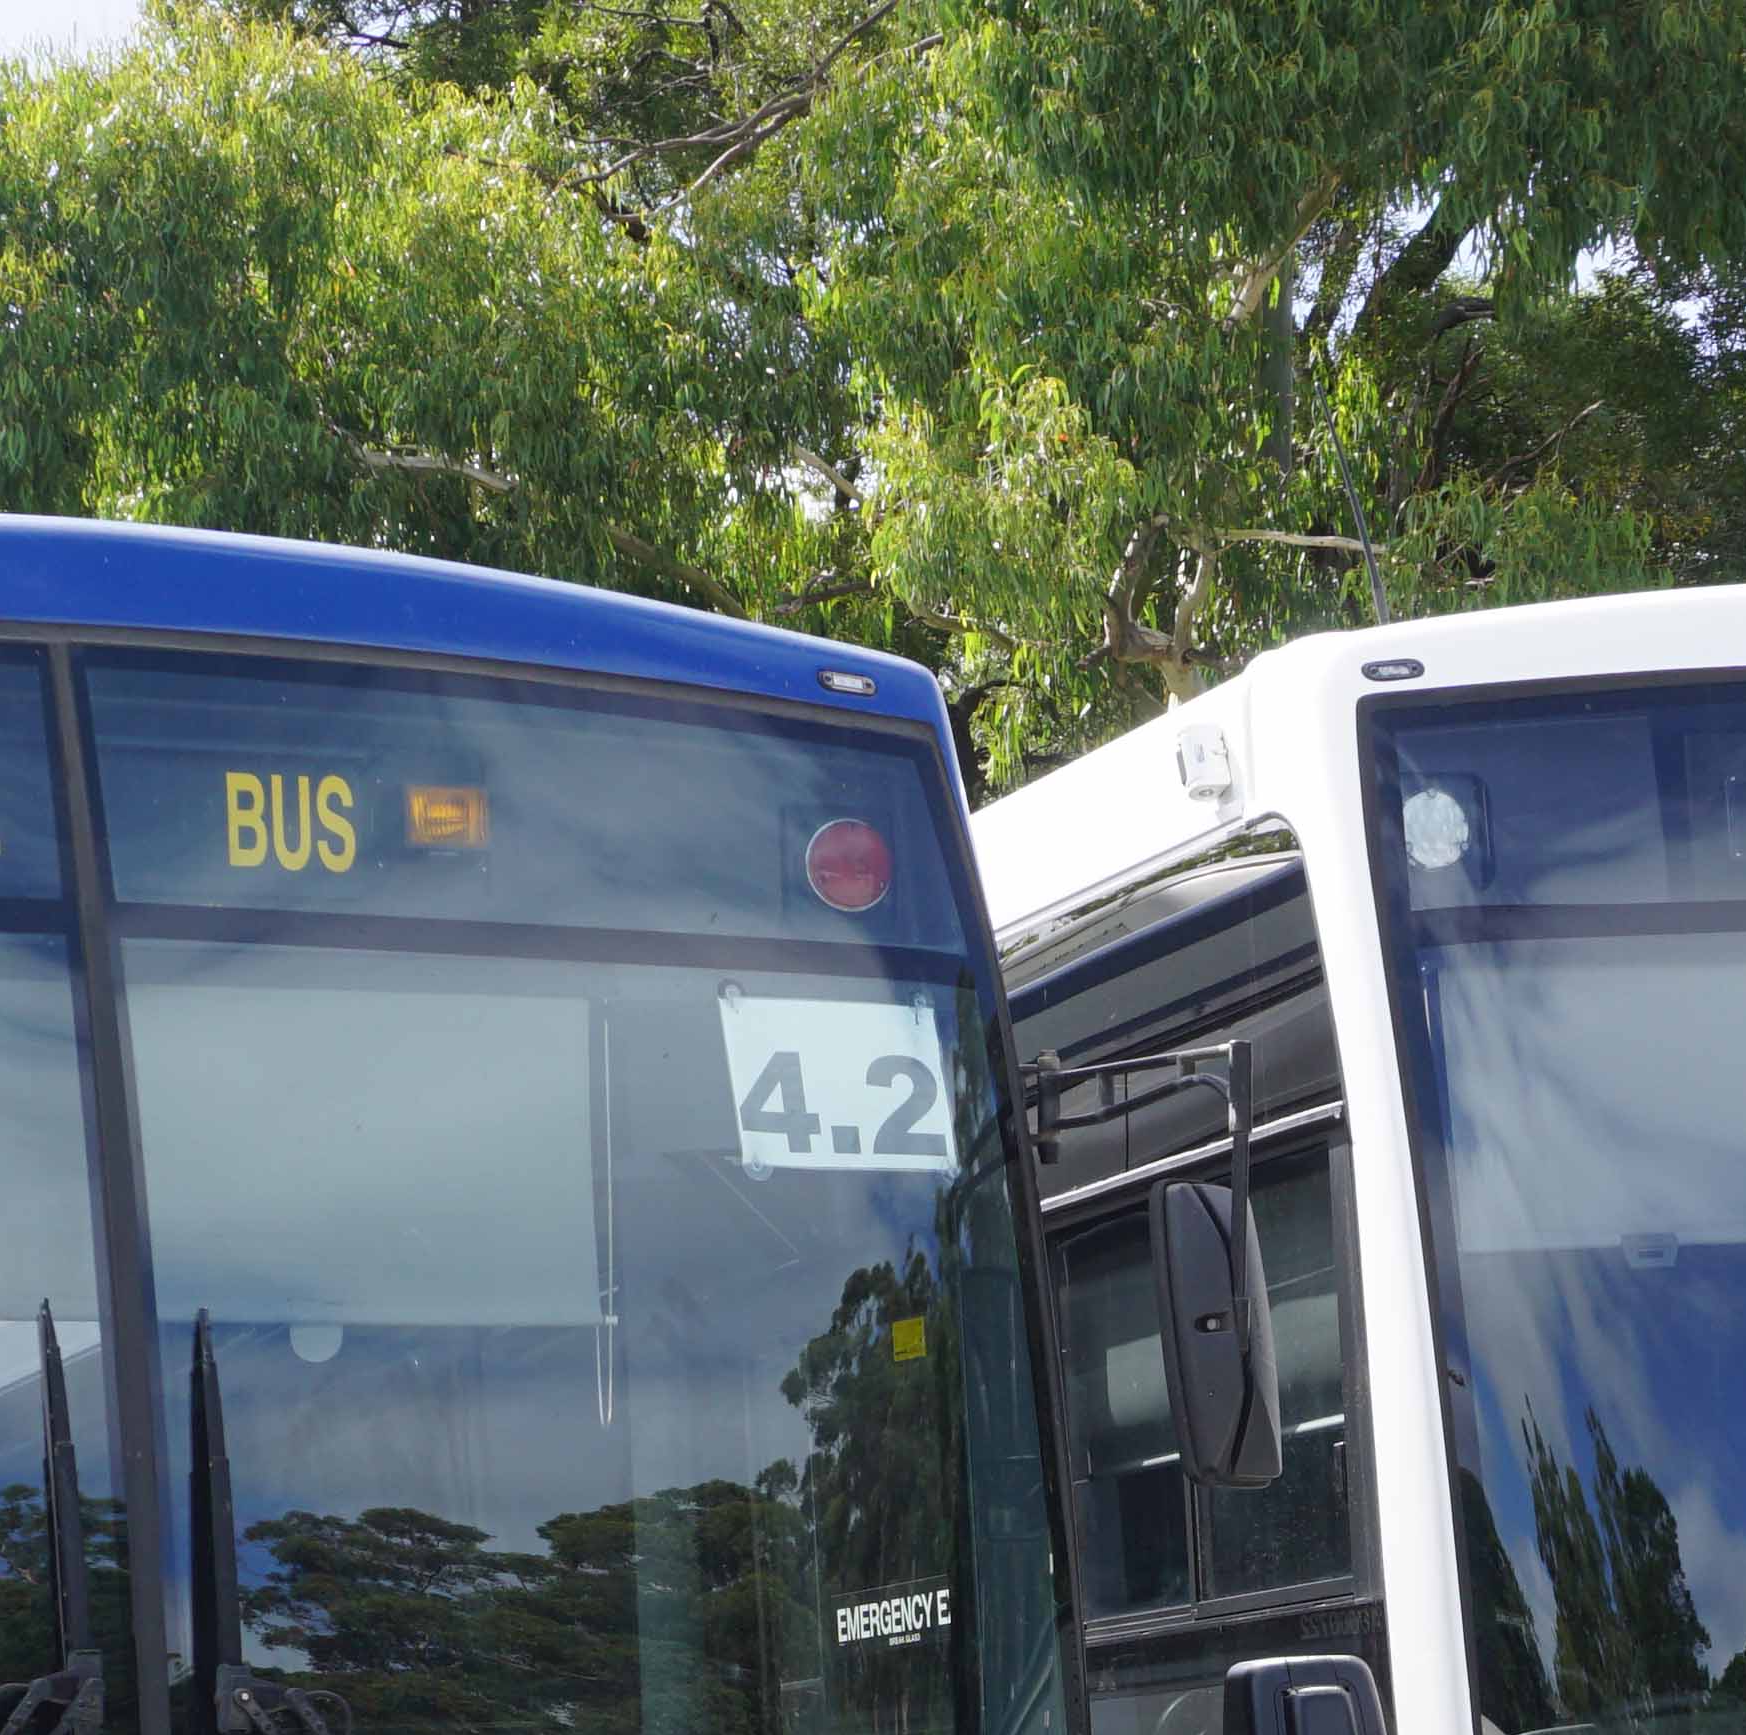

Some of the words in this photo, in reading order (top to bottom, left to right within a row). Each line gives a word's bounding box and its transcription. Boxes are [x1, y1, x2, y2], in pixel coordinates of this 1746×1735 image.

[225, 771, 355, 873] BUS
[739, 1051, 947, 1156] 4.2
[836, 1591, 934, 1643] EMERGENCY
